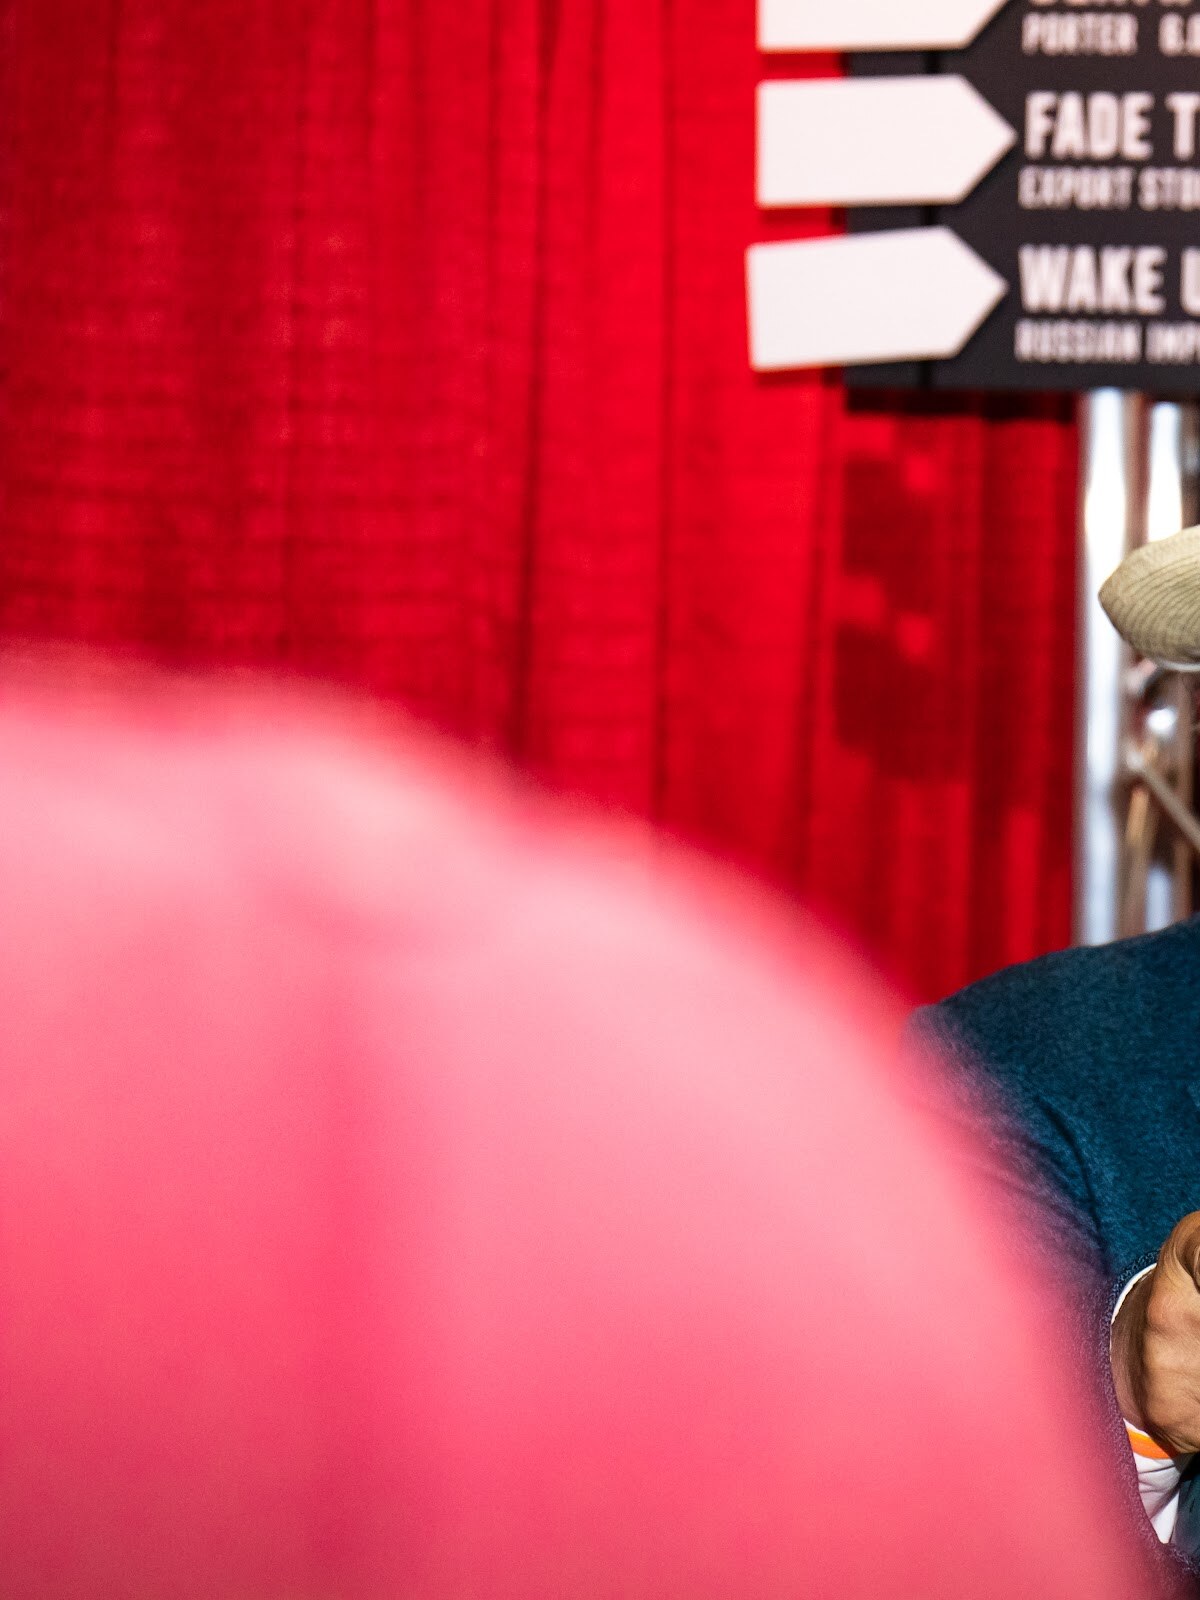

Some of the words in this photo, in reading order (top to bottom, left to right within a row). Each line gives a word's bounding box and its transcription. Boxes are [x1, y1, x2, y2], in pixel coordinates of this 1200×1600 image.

[1022, 12, 1138, 55] PORTER
[1025, 91, 1154, 159] FADE
[1018, 166, 1133, 209] EXPORT
[1018, 245, 1166, 314] WAKE
[1014, 319, 1142, 362] RUSSIAN
